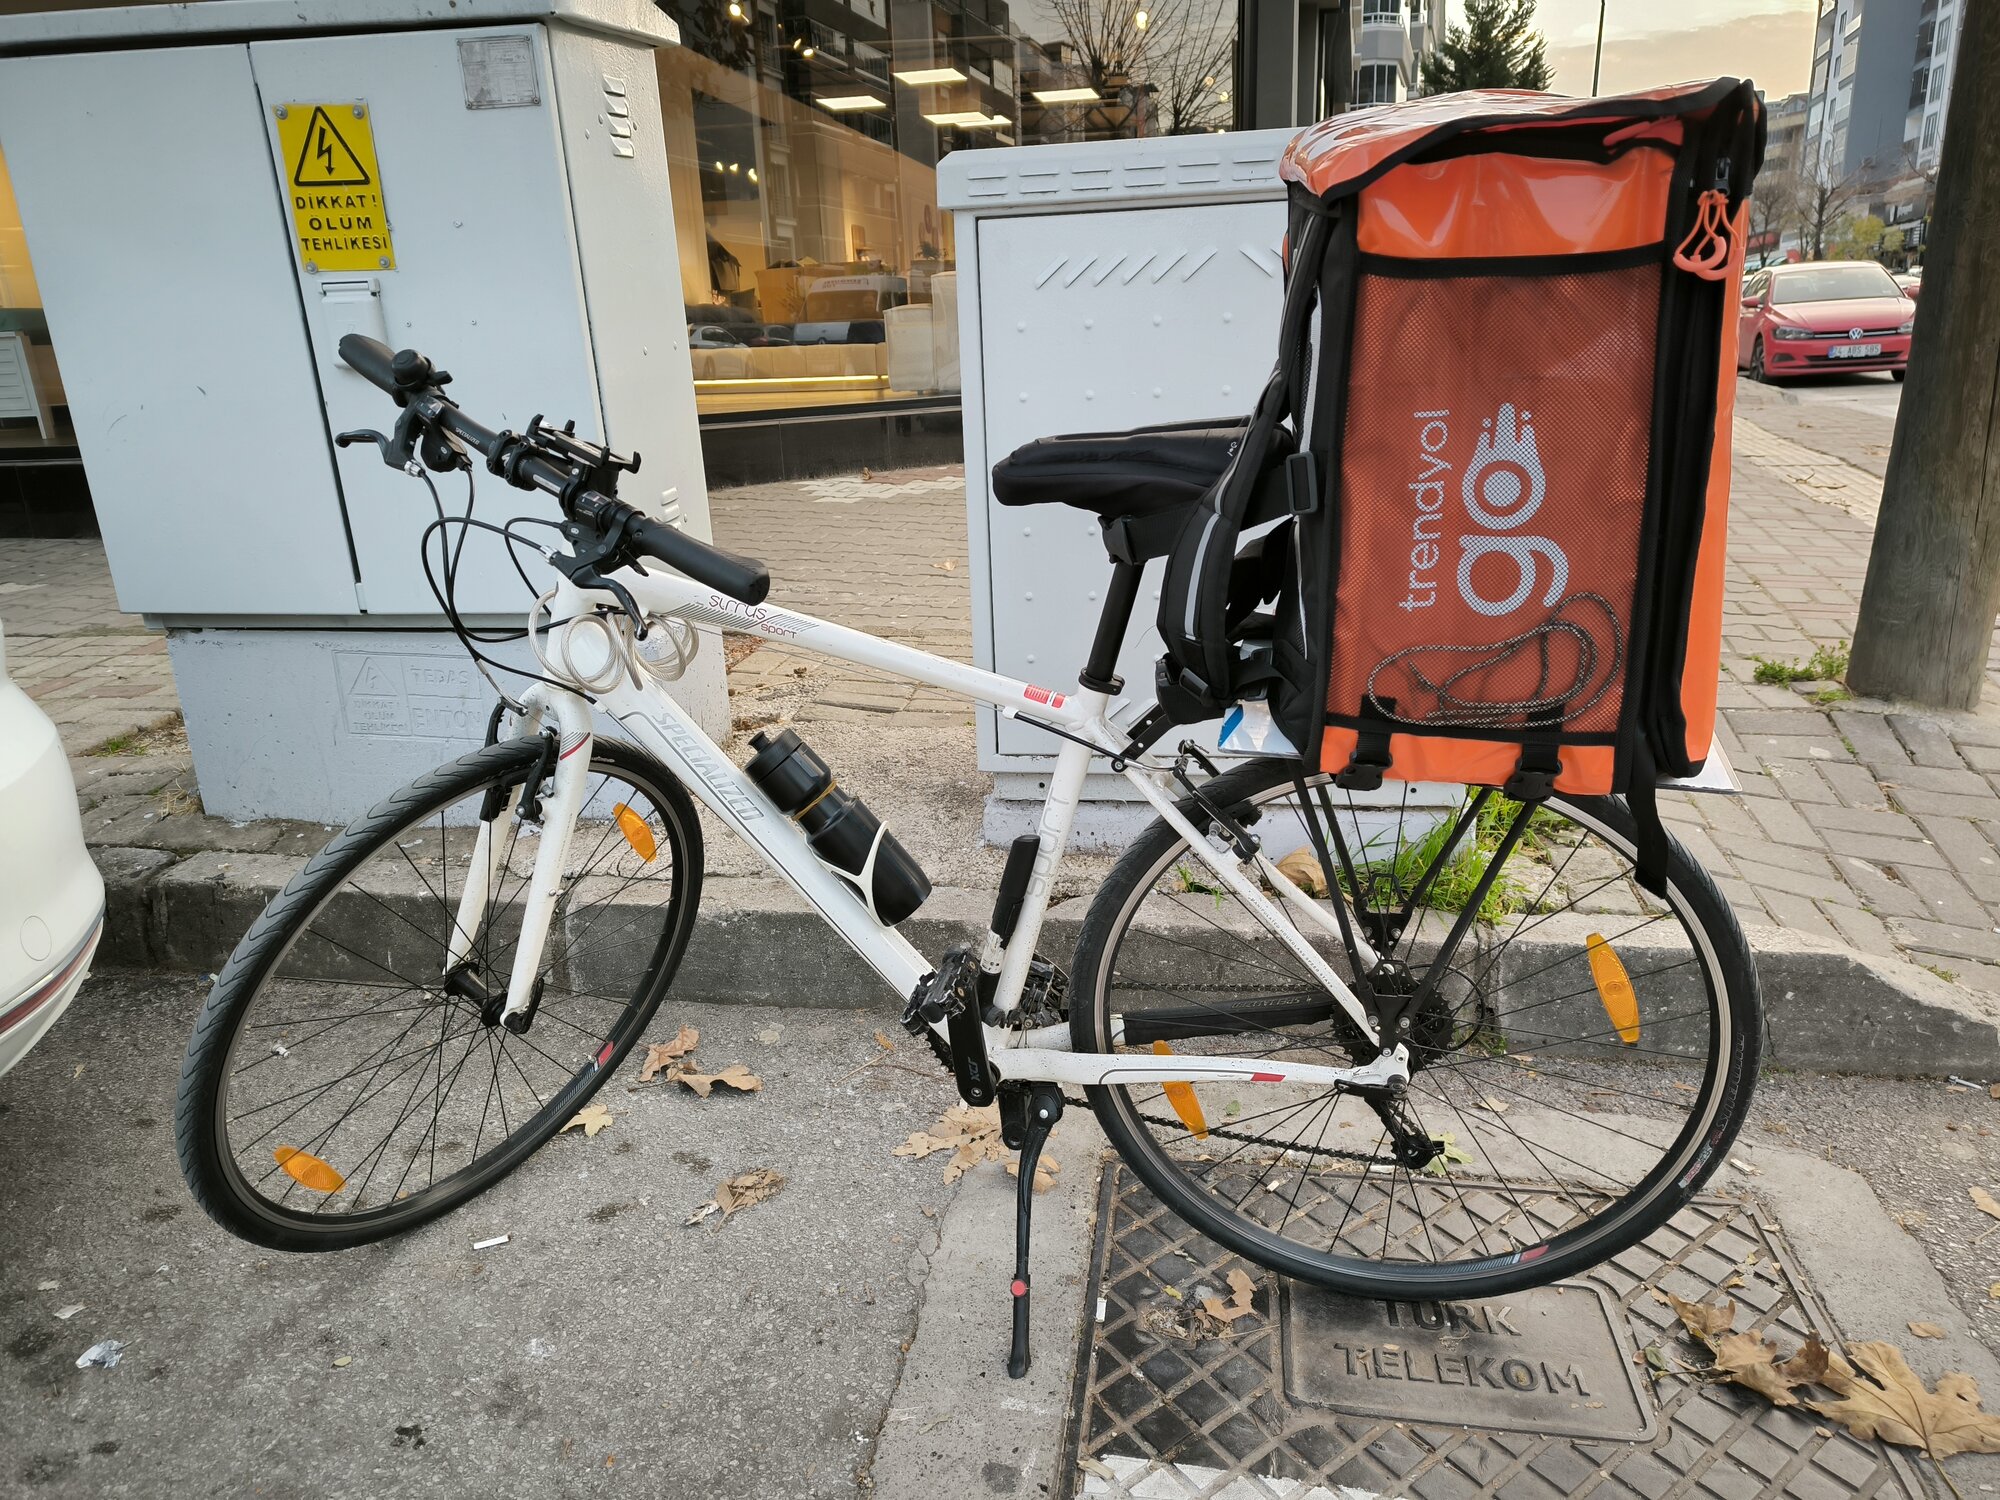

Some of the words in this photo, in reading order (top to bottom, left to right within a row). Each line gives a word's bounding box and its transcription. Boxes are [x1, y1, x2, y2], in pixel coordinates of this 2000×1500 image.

[301, 233, 387, 251] TEHLİKESİ
[309, 214, 372, 231] ÖLÜM
[1399, 409, 1452, 613] trendyol
[1457, 403, 1569, 617] go
[708, 594, 767, 620] sirrus
[652, 712, 765, 821] SPECIALIZED
[1333, 1341, 1591, 1398] TELEKOM
